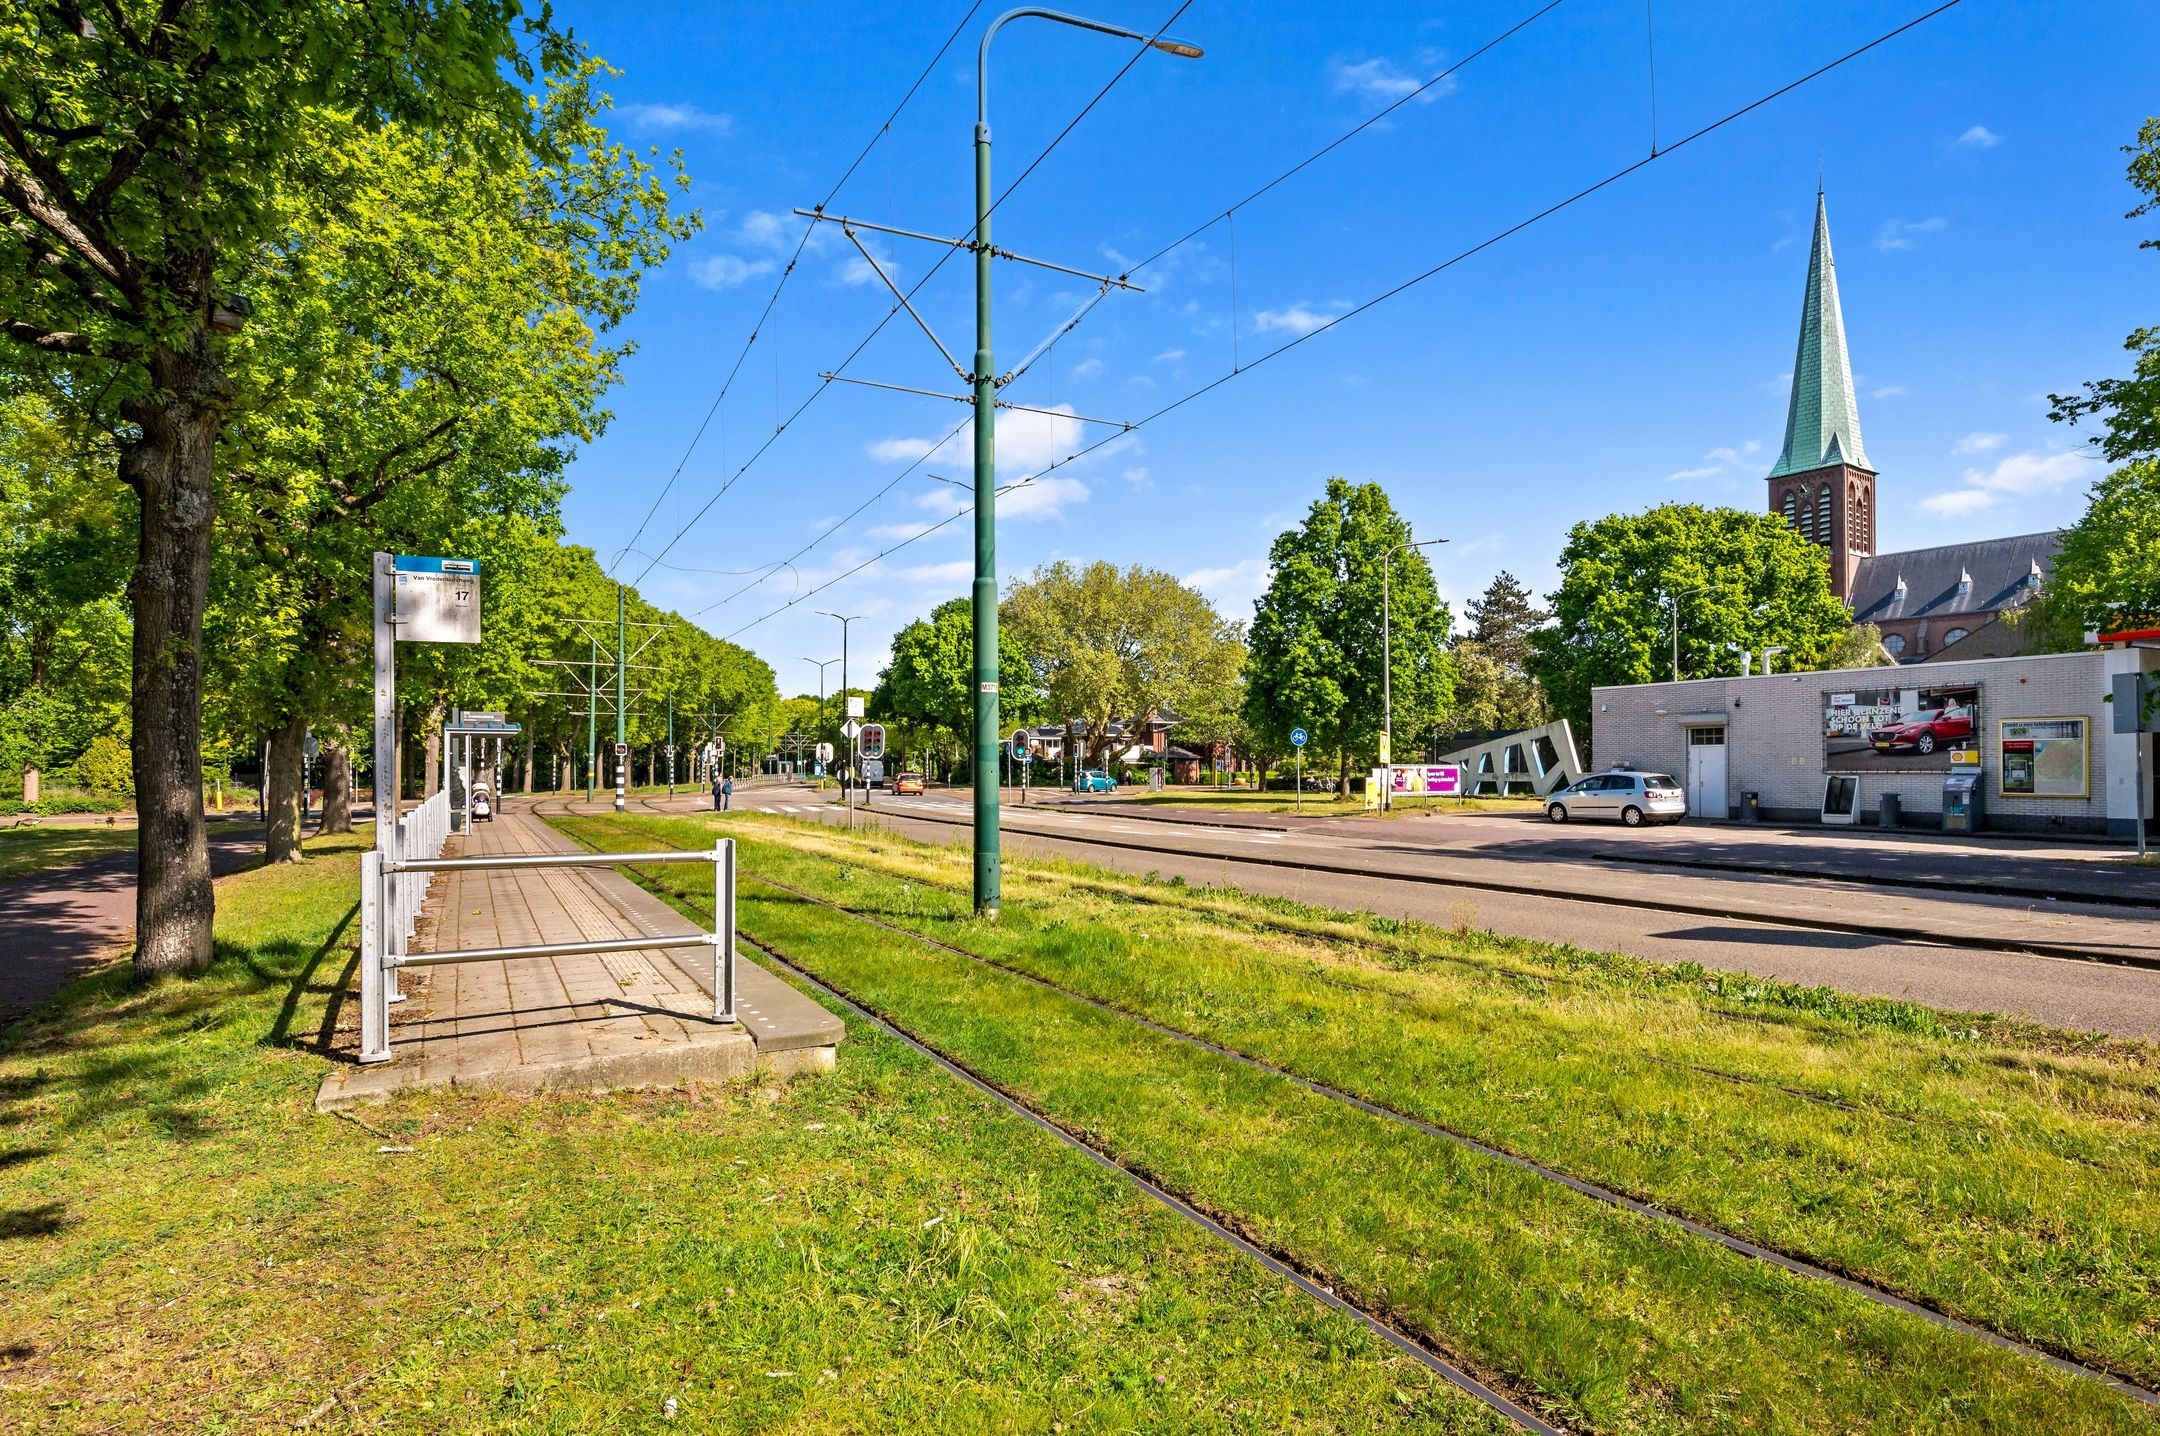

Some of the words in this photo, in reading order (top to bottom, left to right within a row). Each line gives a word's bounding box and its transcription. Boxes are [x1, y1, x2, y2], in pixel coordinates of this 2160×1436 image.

[455, 591, 469, 601] 17
[1831, 709, 1851, 717] HIER
[1853, 707, 1904, 715] GLANZEND
[1831, 715, 1870, 723] SCHOON
[1831, 723, 1844, 731] OP
[1846, 722, 1858, 731] DE
